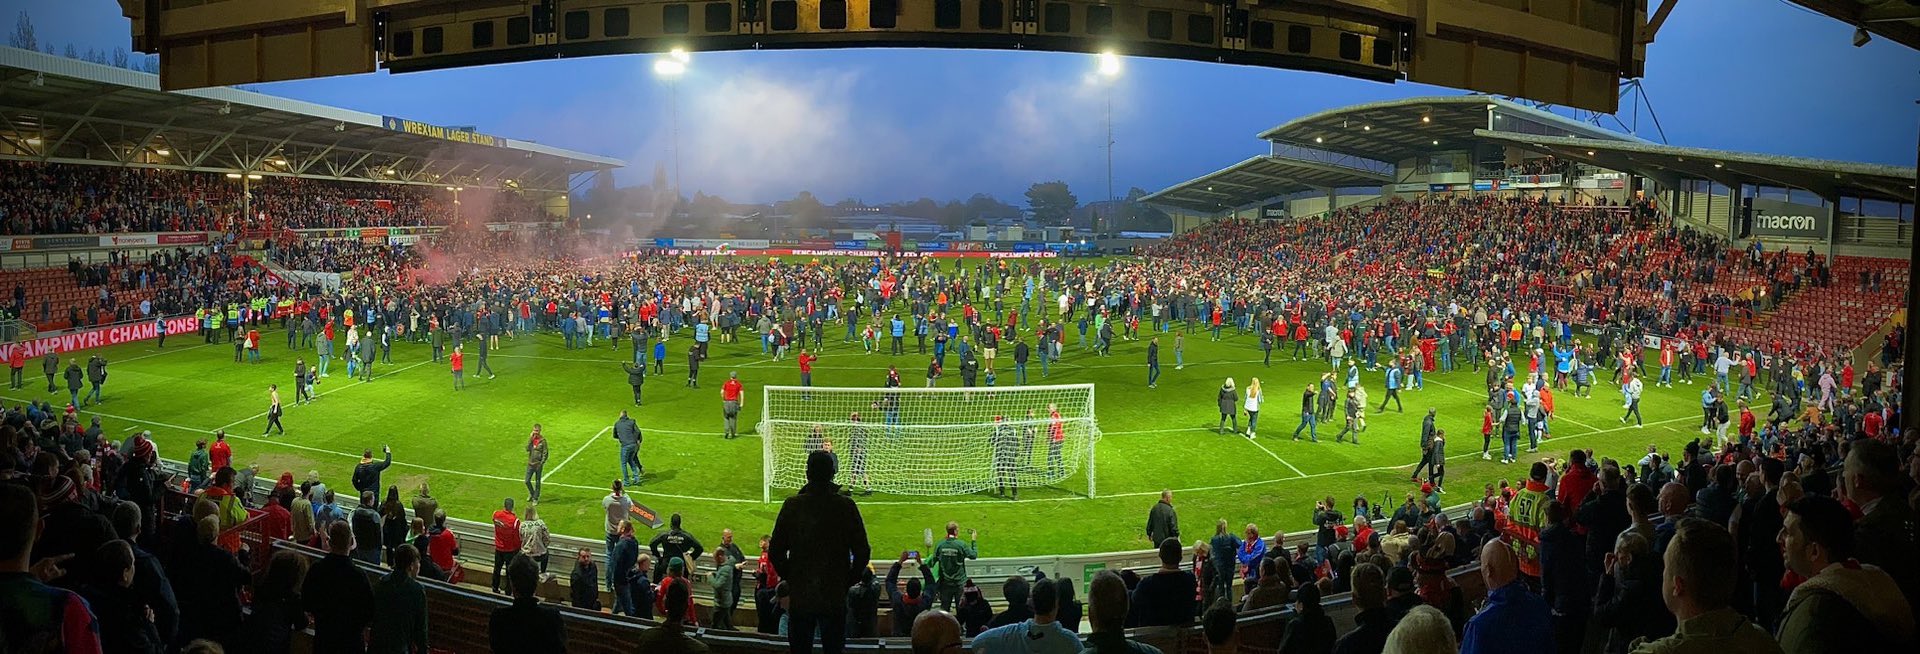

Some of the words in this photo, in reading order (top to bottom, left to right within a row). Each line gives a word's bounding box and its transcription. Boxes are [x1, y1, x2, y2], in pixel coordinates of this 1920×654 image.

[446, 128, 470, 144] LAGER
[471, 133, 494, 147] STAND
[1757, 215, 1815, 230] macron
[110, 317, 199, 344] CHAMONS!
